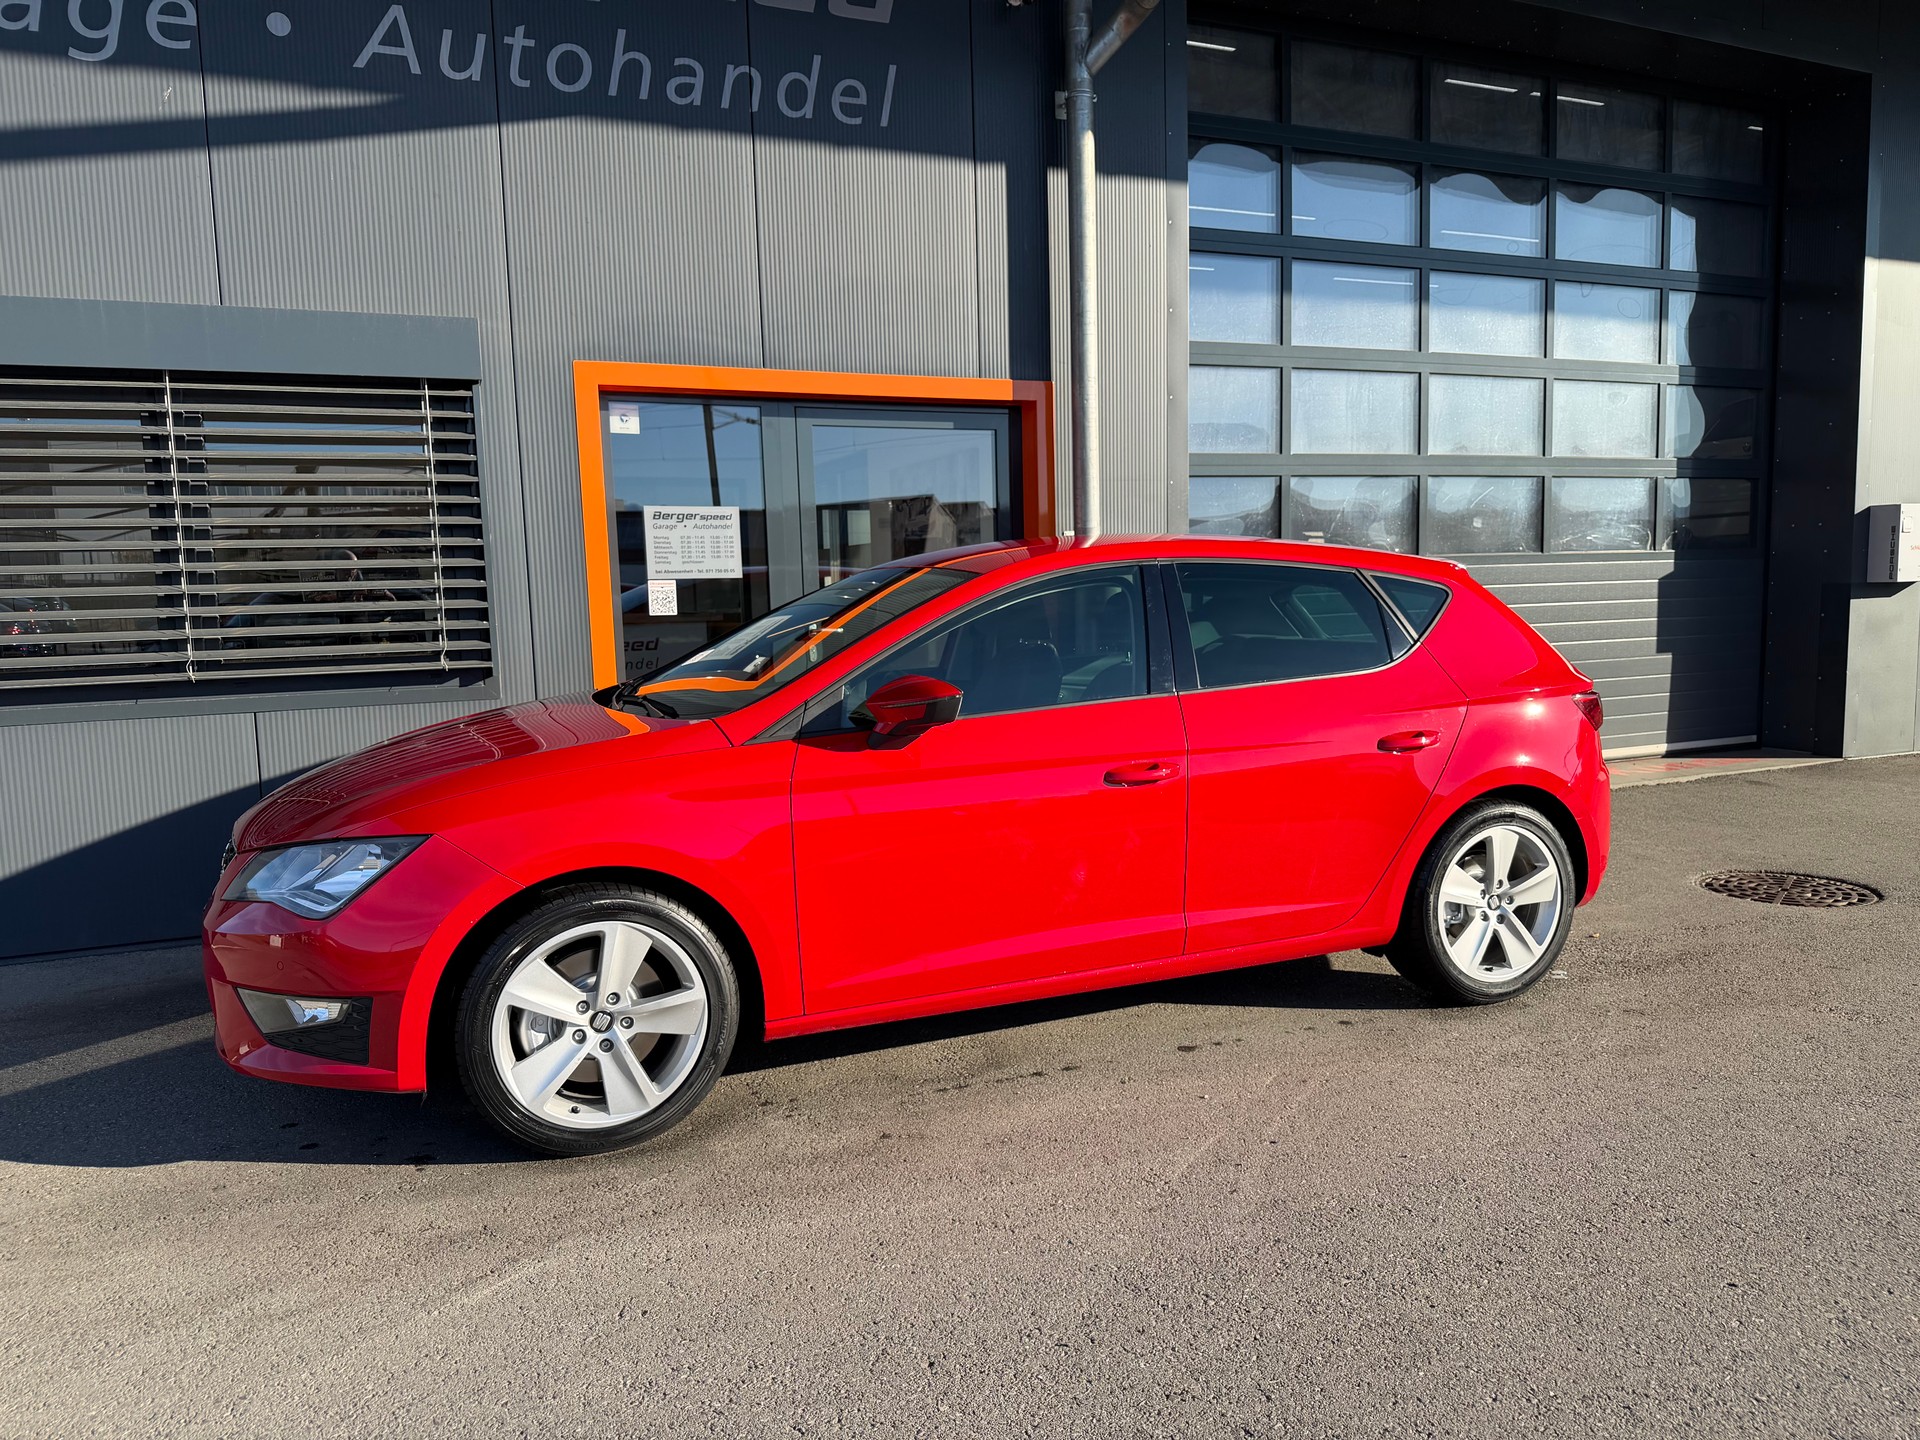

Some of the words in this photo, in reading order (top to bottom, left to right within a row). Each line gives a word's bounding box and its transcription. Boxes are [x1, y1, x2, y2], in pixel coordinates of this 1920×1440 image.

[353, 4, 897, 127] Autohandel
[652, 511, 733, 523] Bergerspeed
[652, 523, 678, 531] Garage
